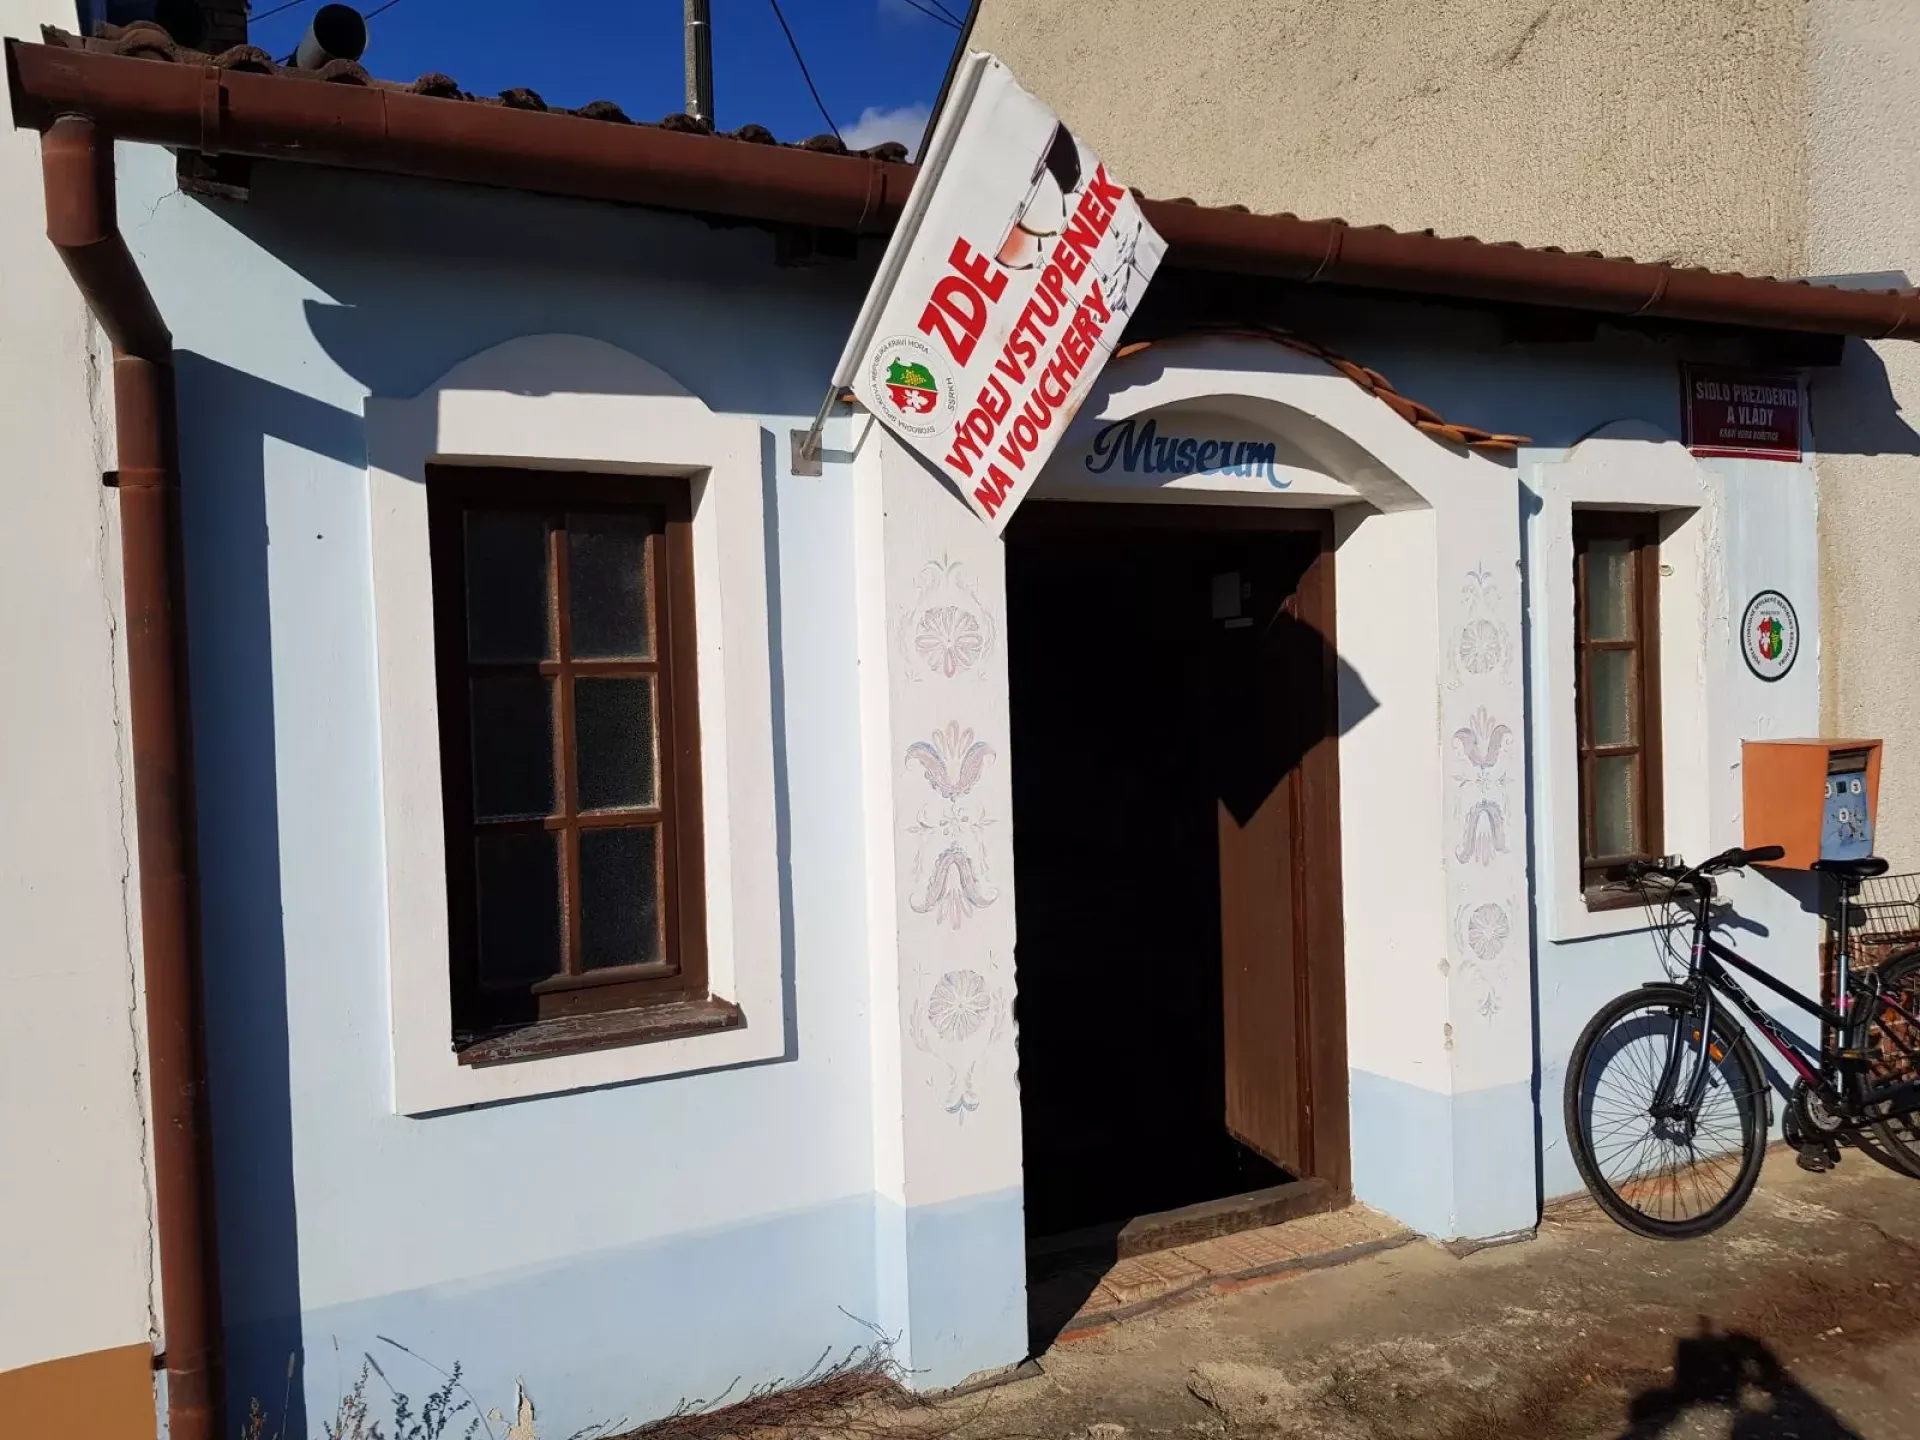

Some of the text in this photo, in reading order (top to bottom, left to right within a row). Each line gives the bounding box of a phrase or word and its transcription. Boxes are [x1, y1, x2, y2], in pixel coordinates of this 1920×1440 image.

[918, 236, 1009, 368] ZDE
[945, 162, 1125, 477] VÝDEJ VSTUPENEK
[908, 340, 929, 354] HORA
[974, 279, 1112, 518] NA VOUCHERY
[1696, 378, 1797, 408] SÍDLO PREZIDENTA
[1727, 404, 1774, 426] A VLÁDY
[1086, 419, 1292, 489] Museum
